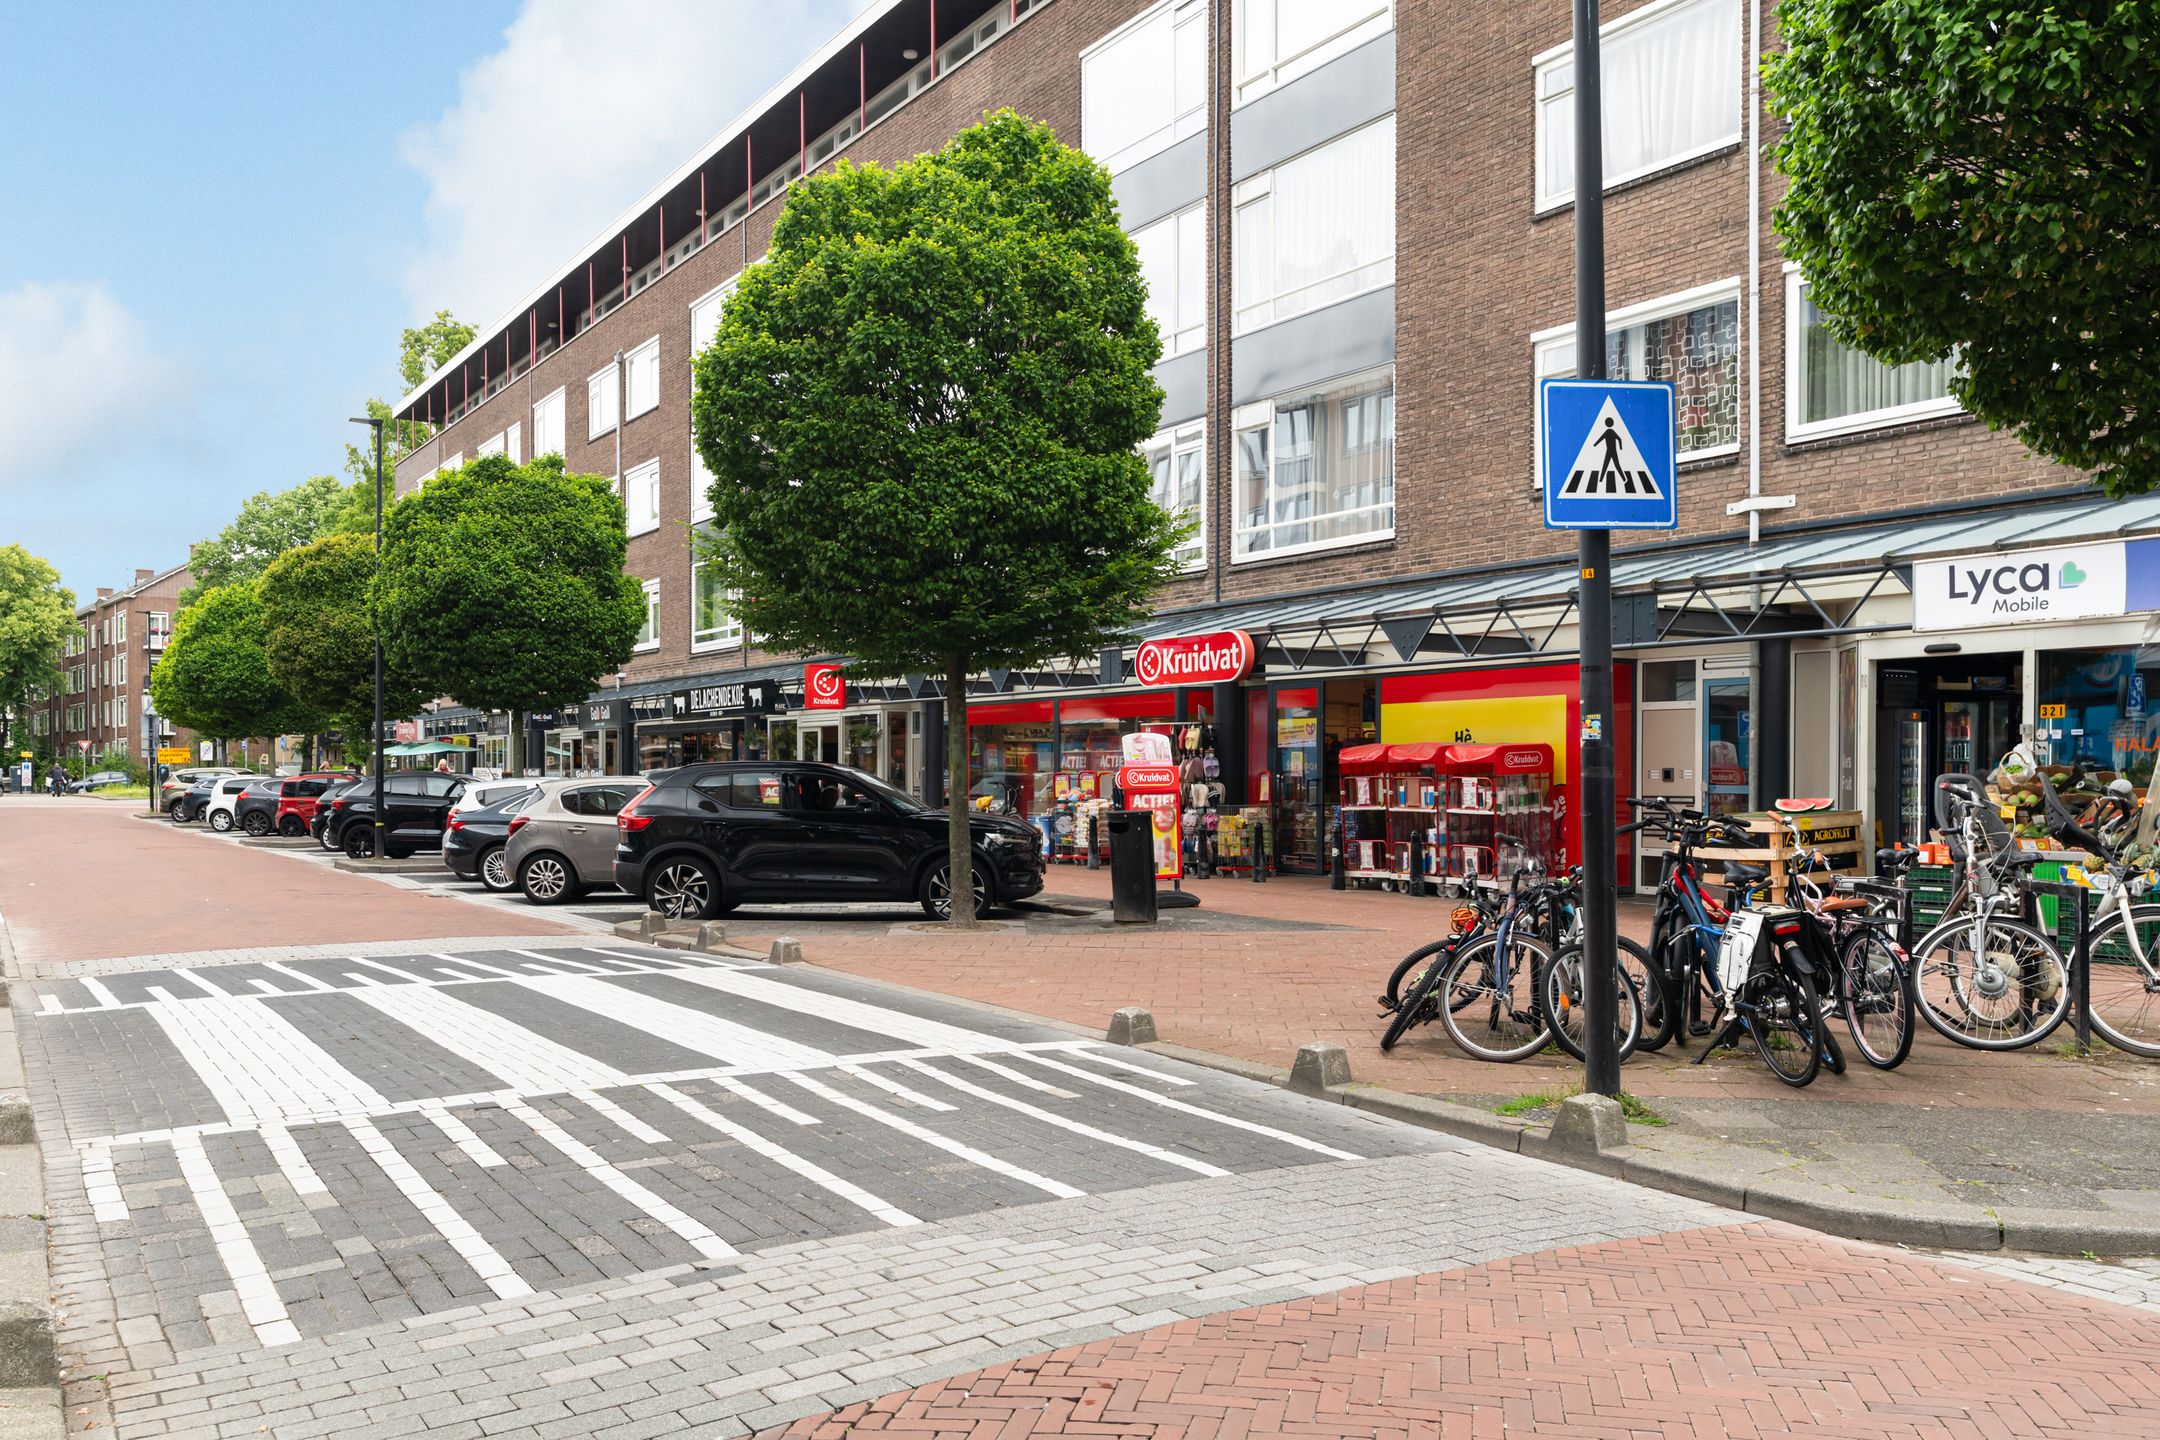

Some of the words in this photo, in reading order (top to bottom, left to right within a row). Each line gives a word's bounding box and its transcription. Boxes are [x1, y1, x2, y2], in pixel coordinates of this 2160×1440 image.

[1948, 562, 2050, 604] Lyca
[1992, 596, 2049, 613] Mobile
[1162, 642, 1240, 675] Kruidvat
[690, 689, 698, 709] DE
[699, 686, 731, 709] LACHENDE
[732, 684, 745, 705] KOE
[813, 697, 839, 705] Kruidvat
[2041, 706, 2063, 717] 321
[1514, 754, 1539, 763] Kruidvat
[576, 770, 588, 778] Gall
[591, 769, 603, 777] Gall
[1139, 772, 1170, 782] Kruidvat
[1133, 794, 1175, 808] ACTIE!
